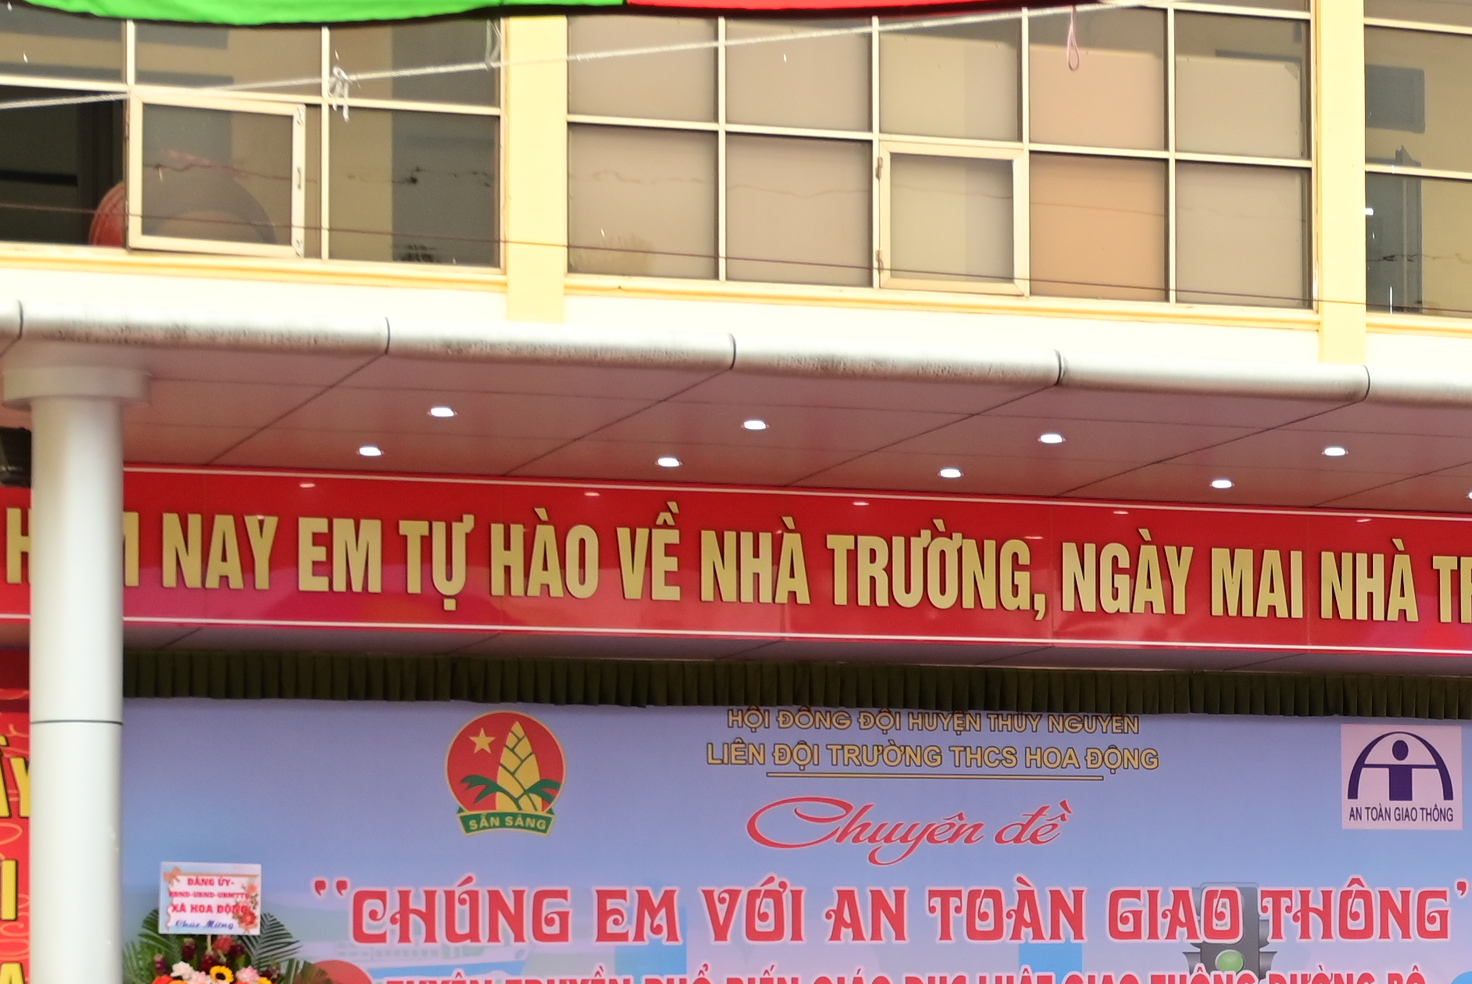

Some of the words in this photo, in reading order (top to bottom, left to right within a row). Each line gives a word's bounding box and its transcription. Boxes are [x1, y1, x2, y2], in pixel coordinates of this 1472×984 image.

[161, 511, 279, 590] NAY
[298, 517, 383, 593] EM
[399, 513, 475, 611] TỰ
[489, 507, 600, 600] HÀO
[615, 501, 682, 602] VỀ
[700, 515, 811, 605] NHÀ
[826, 518, 1046, 621] TRƯỜNG,
[1061, 528, 1194, 615] NGÀY
[1210, 547, 1303, 619] MAI
[1320, 538, 1419, 622] NHÀ
[727, 705, 770, 733] HỘI
[858, 707, 900, 735] ĐỘI
[706, 738, 766, 765] LIÊN
[773, 740, 820, 771] ĐỘI
[826, 739, 943, 767] TRƯỜNG
[949, 745, 1019, 768] THCS
[1024, 746, 1081, 769] HOA
[1085, 744, 1160, 774] ĐỘNG
[505, 814, 546, 830] SÀNG
[1349, 806, 1362, 821] AN
[1365, 802, 1392, 822] TOÀN
[1394, 806, 1418, 822] GIAO
[1420, 803, 1454, 822] THÔNG
[745, 796, 985, 867] Chuyên
[994, 799, 1074, 846] đề
[190, 904, 213, 914] HOA
[594, 887, 681, 944] EM
[700, 875, 806, 944] VỚI
[824, 888, 909, 943] AN
[927, 876, 1087, 942] TOÀN
[1107, 885, 1245, 943] GIAO
